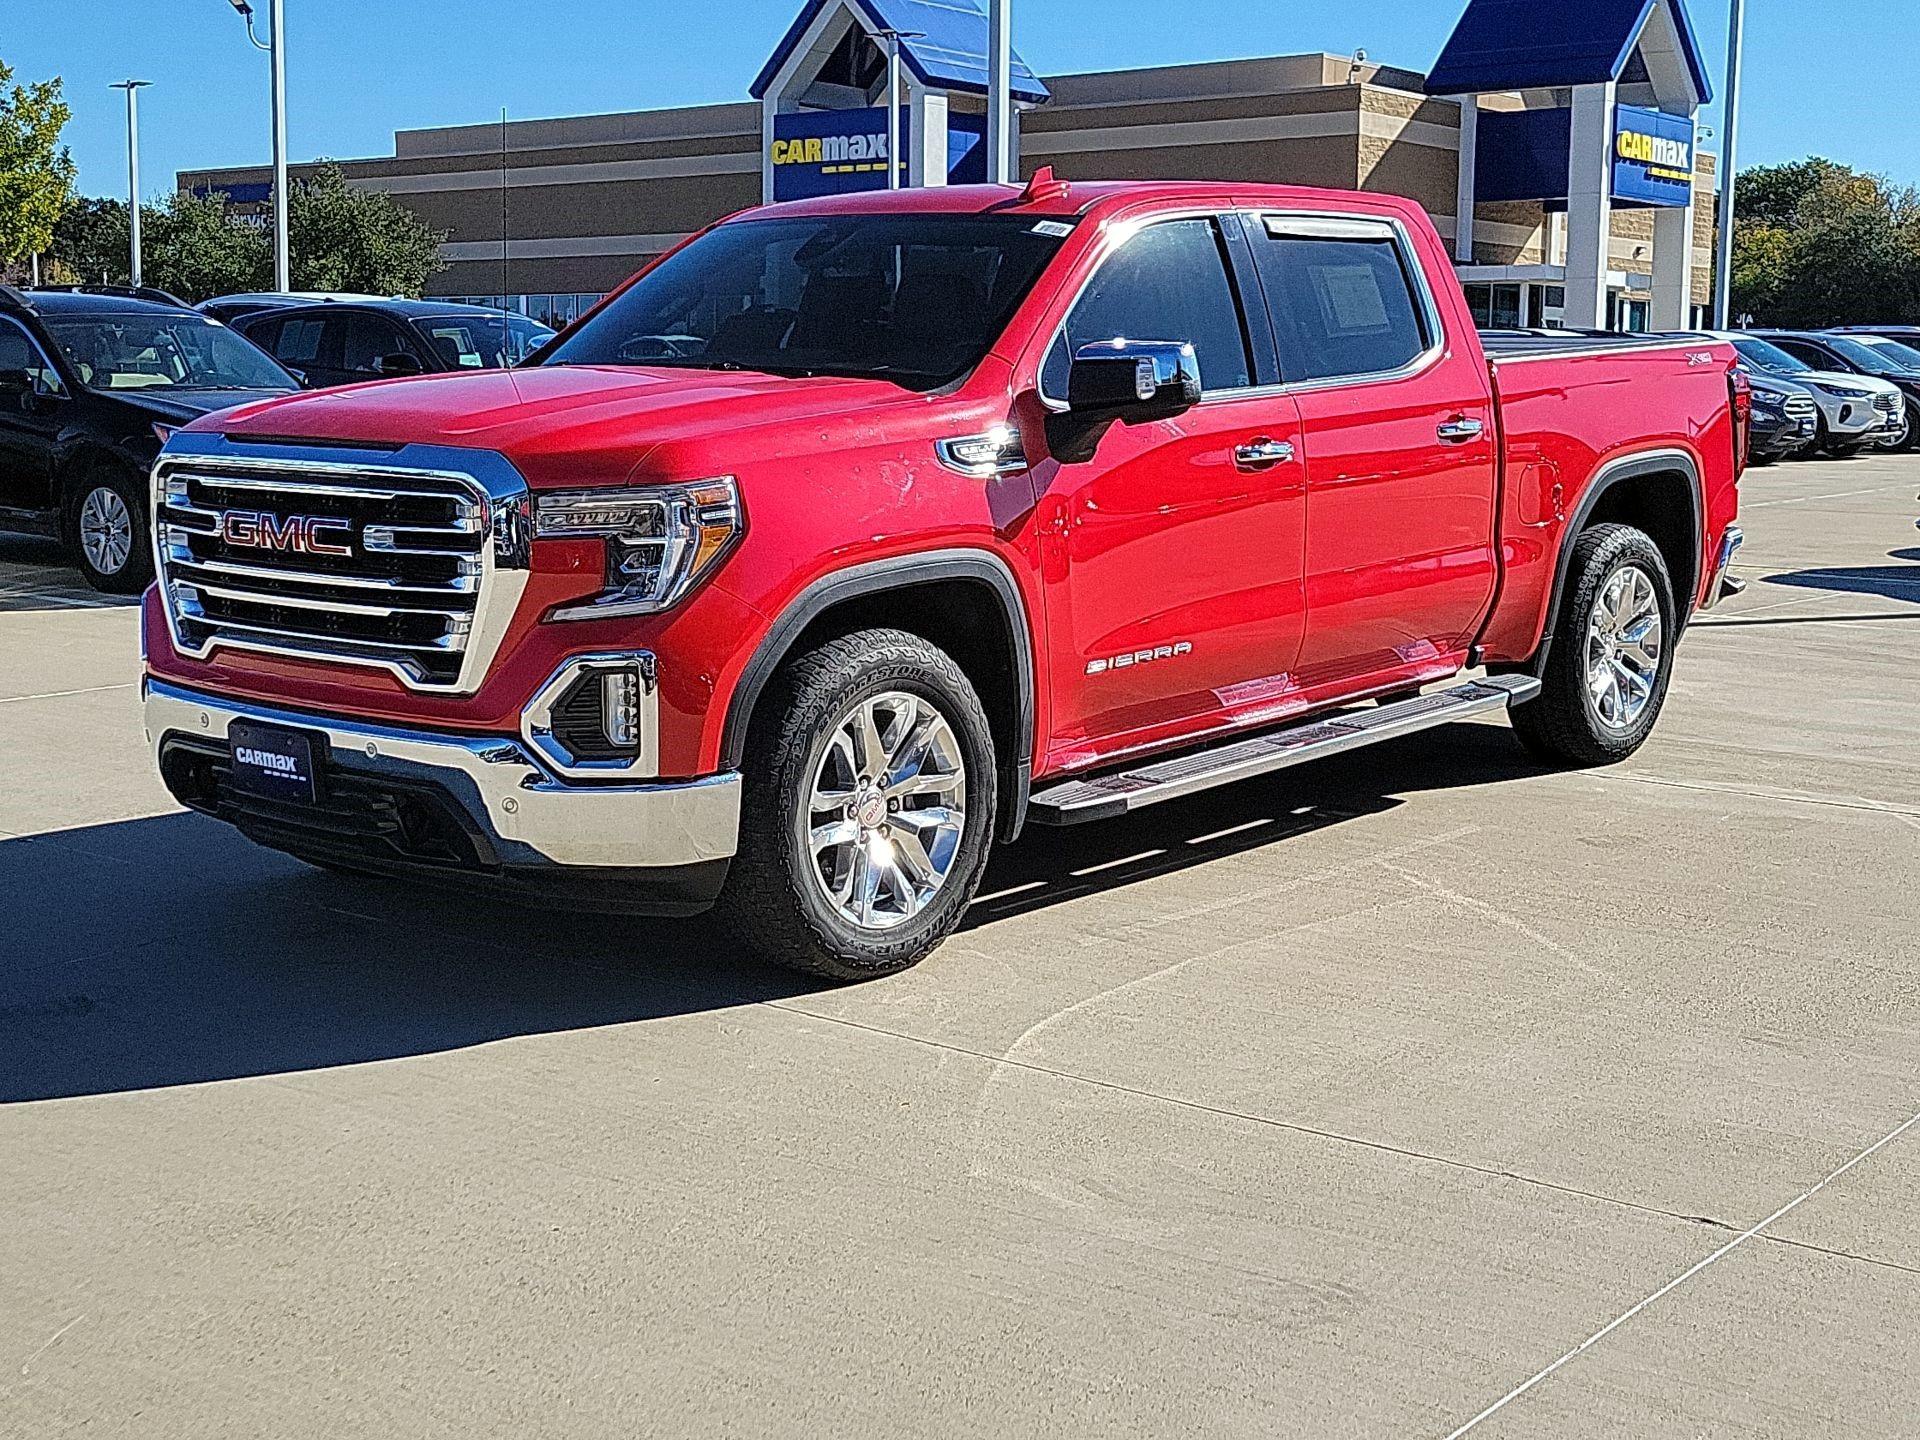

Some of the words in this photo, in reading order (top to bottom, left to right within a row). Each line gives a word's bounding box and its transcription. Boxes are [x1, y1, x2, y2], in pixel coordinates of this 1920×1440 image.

[771, 133, 888, 165] CARmax
[1617, 130, 1689, 168] CARmax
[223, 509, 352, 557] GMC
[1085, 641, 1192, 674] SIERRA
[236, 746, 297, 772] CARmax
